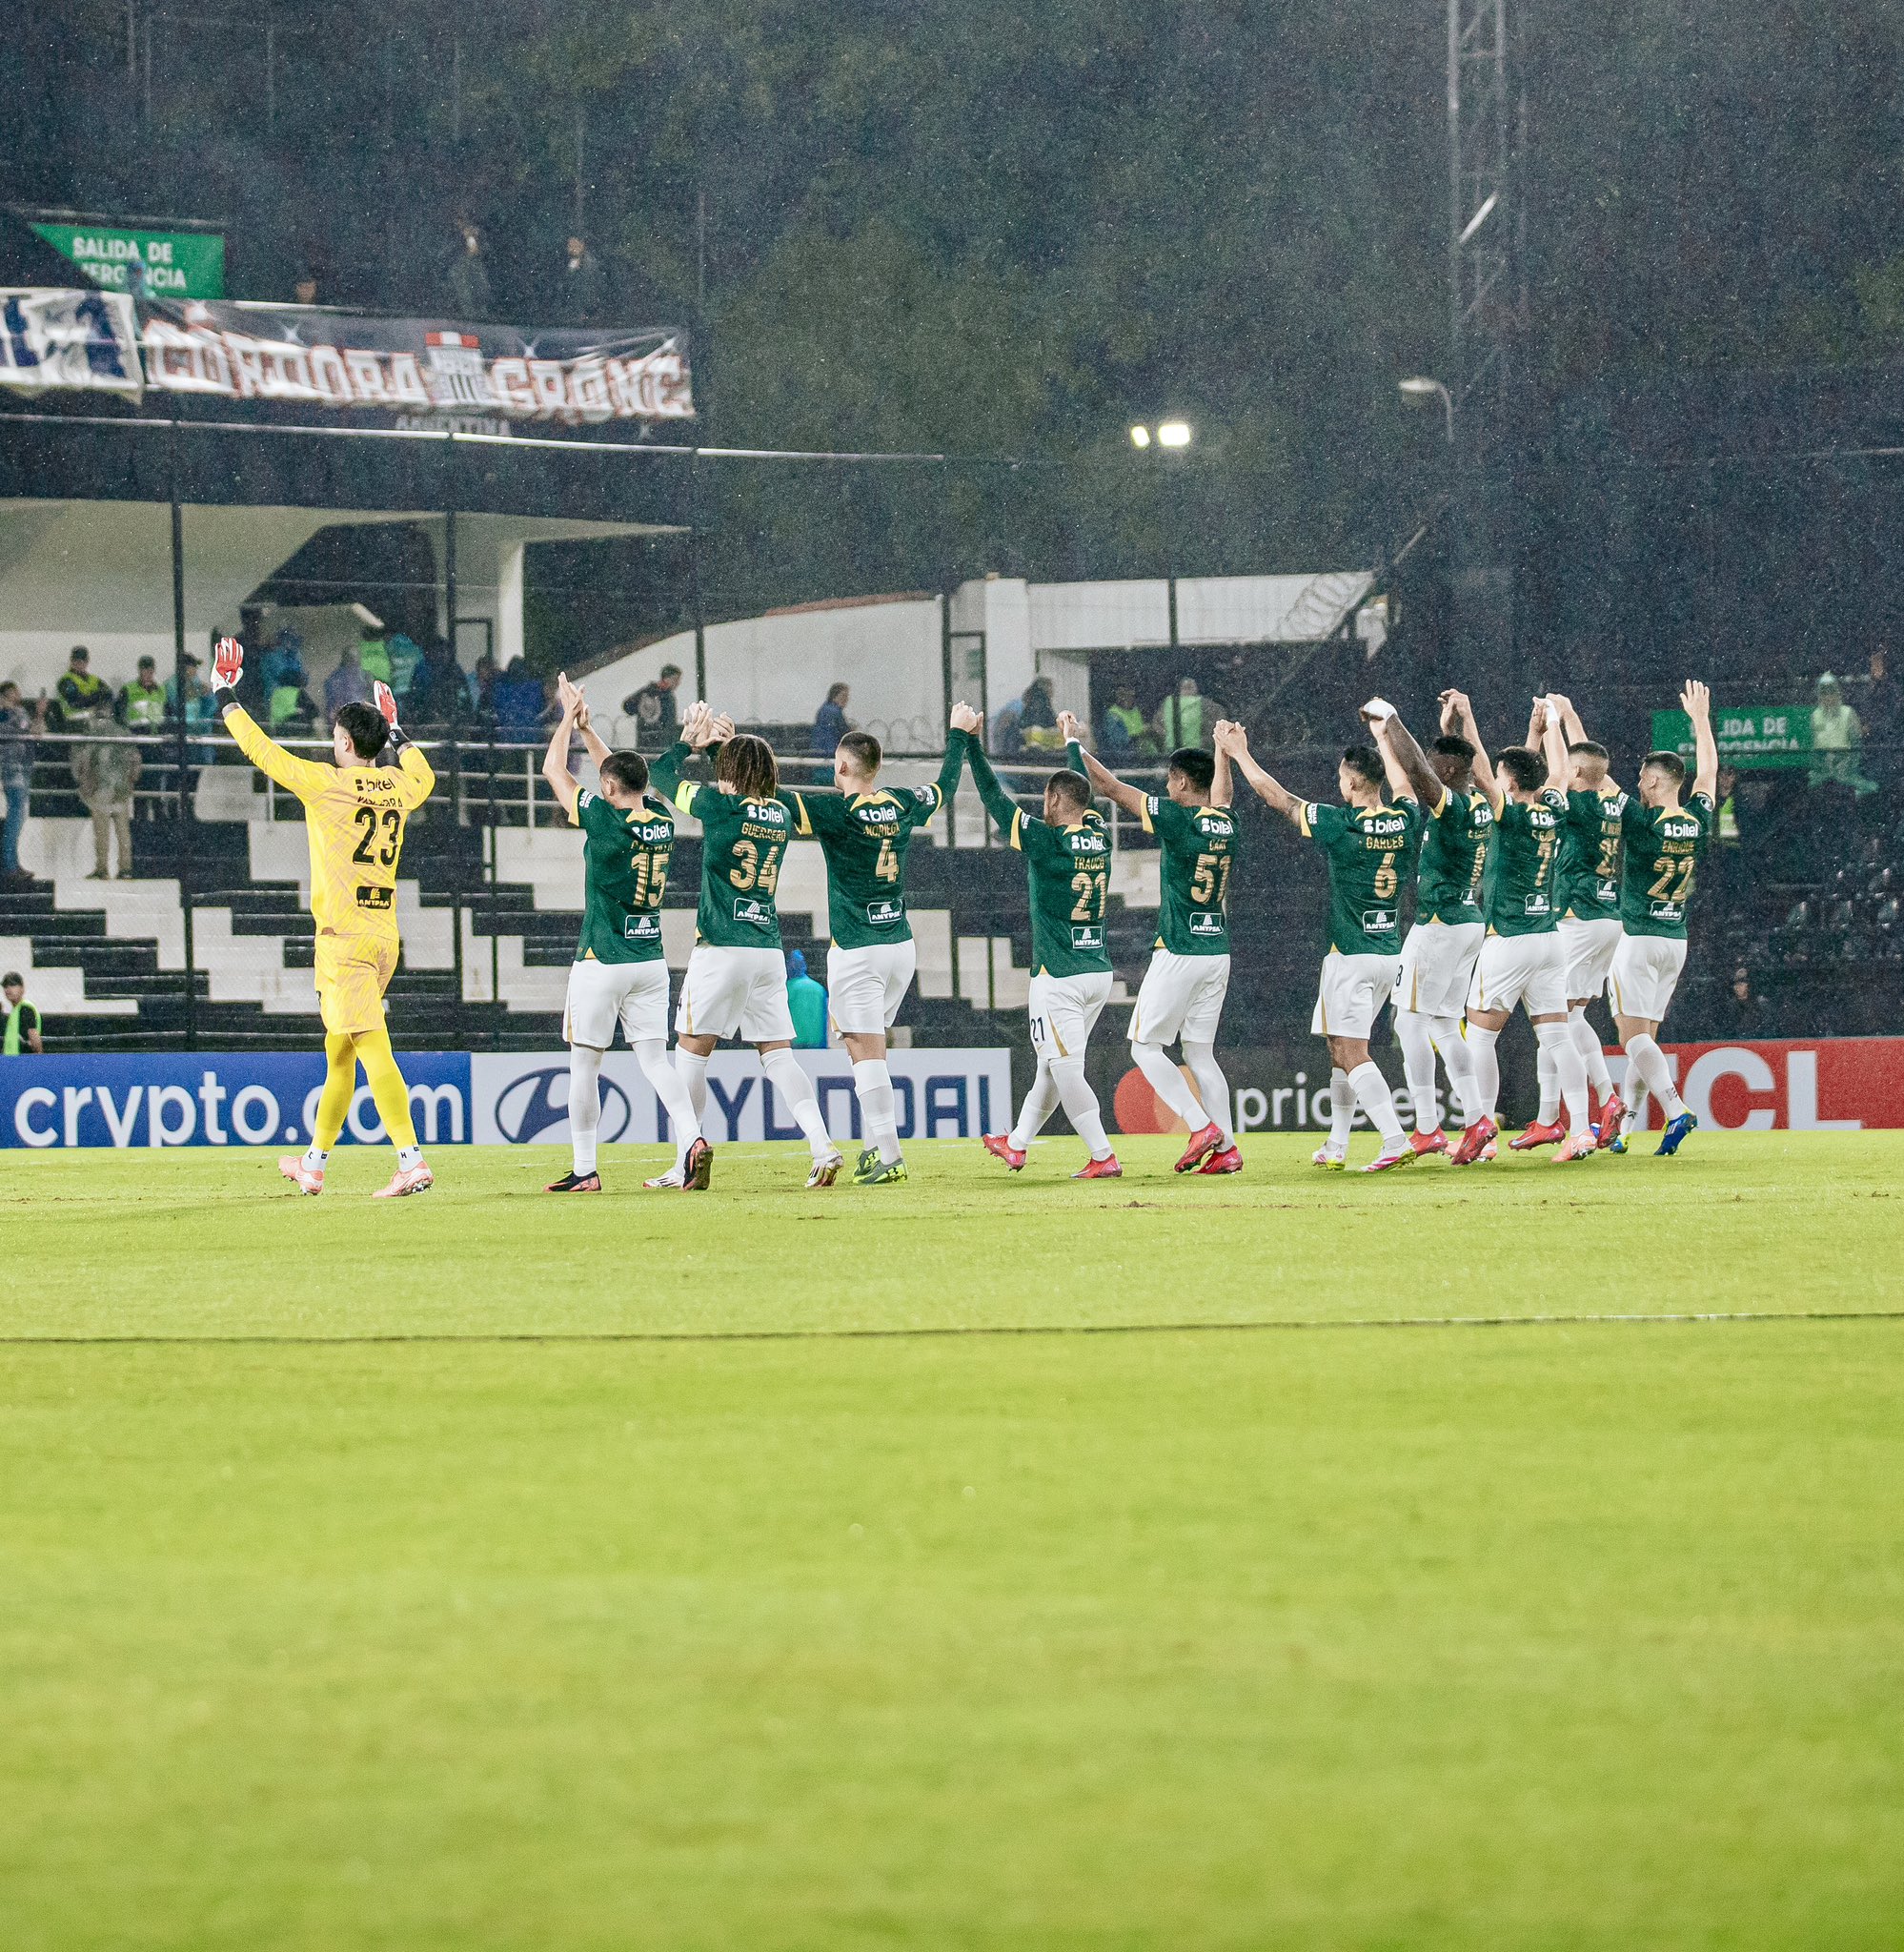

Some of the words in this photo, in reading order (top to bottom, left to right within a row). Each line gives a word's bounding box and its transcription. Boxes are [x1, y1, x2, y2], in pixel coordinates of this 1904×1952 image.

[72, 237, 140, 259] SALIDA
[148, 242, 172, 263] DE
[1763, 717, 1787, 734] DE
[366, 778, 395, 792] bitel
[759, 807, 784, 824] bitel
[869, 805, 898, 823] bitel
[1376, 817, 1406, 834] bitel
[352, 806, 401, 867] 23
[643, 822, 670, 842] bitel
[741, 822, 787, 843] GUERRERO
[1672, 824, 1699, 837] bitel
[1081, 837, 1105, 851] bitel
[729, 840, 780, 896] 34
[875, 839, 900, 883] 4
[631, 852, 670, 908] 15
[1191, 853, 1232, 904] 51
[1374, 852, 1398, 899] 6
[1070, 872, 1107, 922] 21
[1030, 1017, 1045, 1042] 21
[1589, 1047, 1861, 1131] TCL
